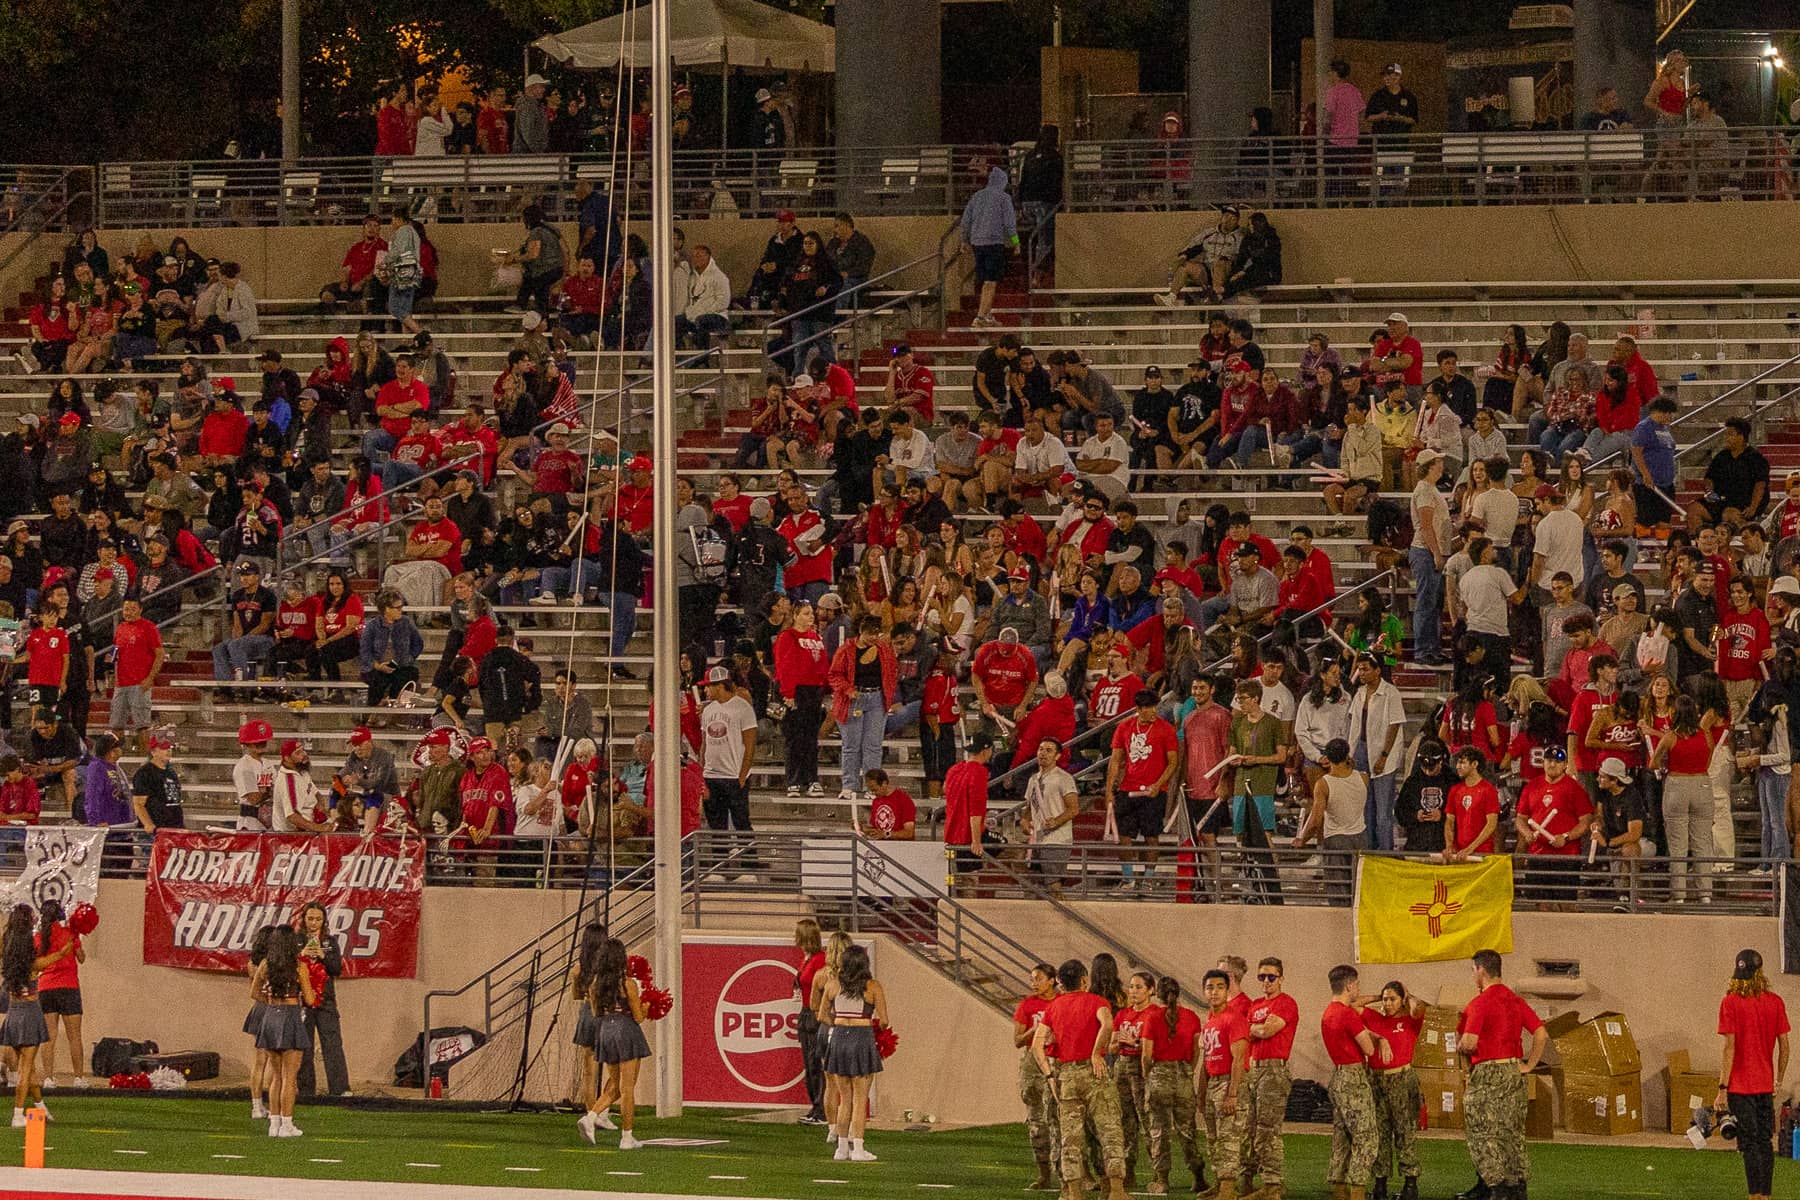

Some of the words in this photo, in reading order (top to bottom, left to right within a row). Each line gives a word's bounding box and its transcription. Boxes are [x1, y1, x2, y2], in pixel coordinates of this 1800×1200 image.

[160, 847, 260, 885] NORTH
[266, 852, 327, 887] END
[331, 855, 413, 891] ZONE
[722, 1012, 800, 1040] PEPS
